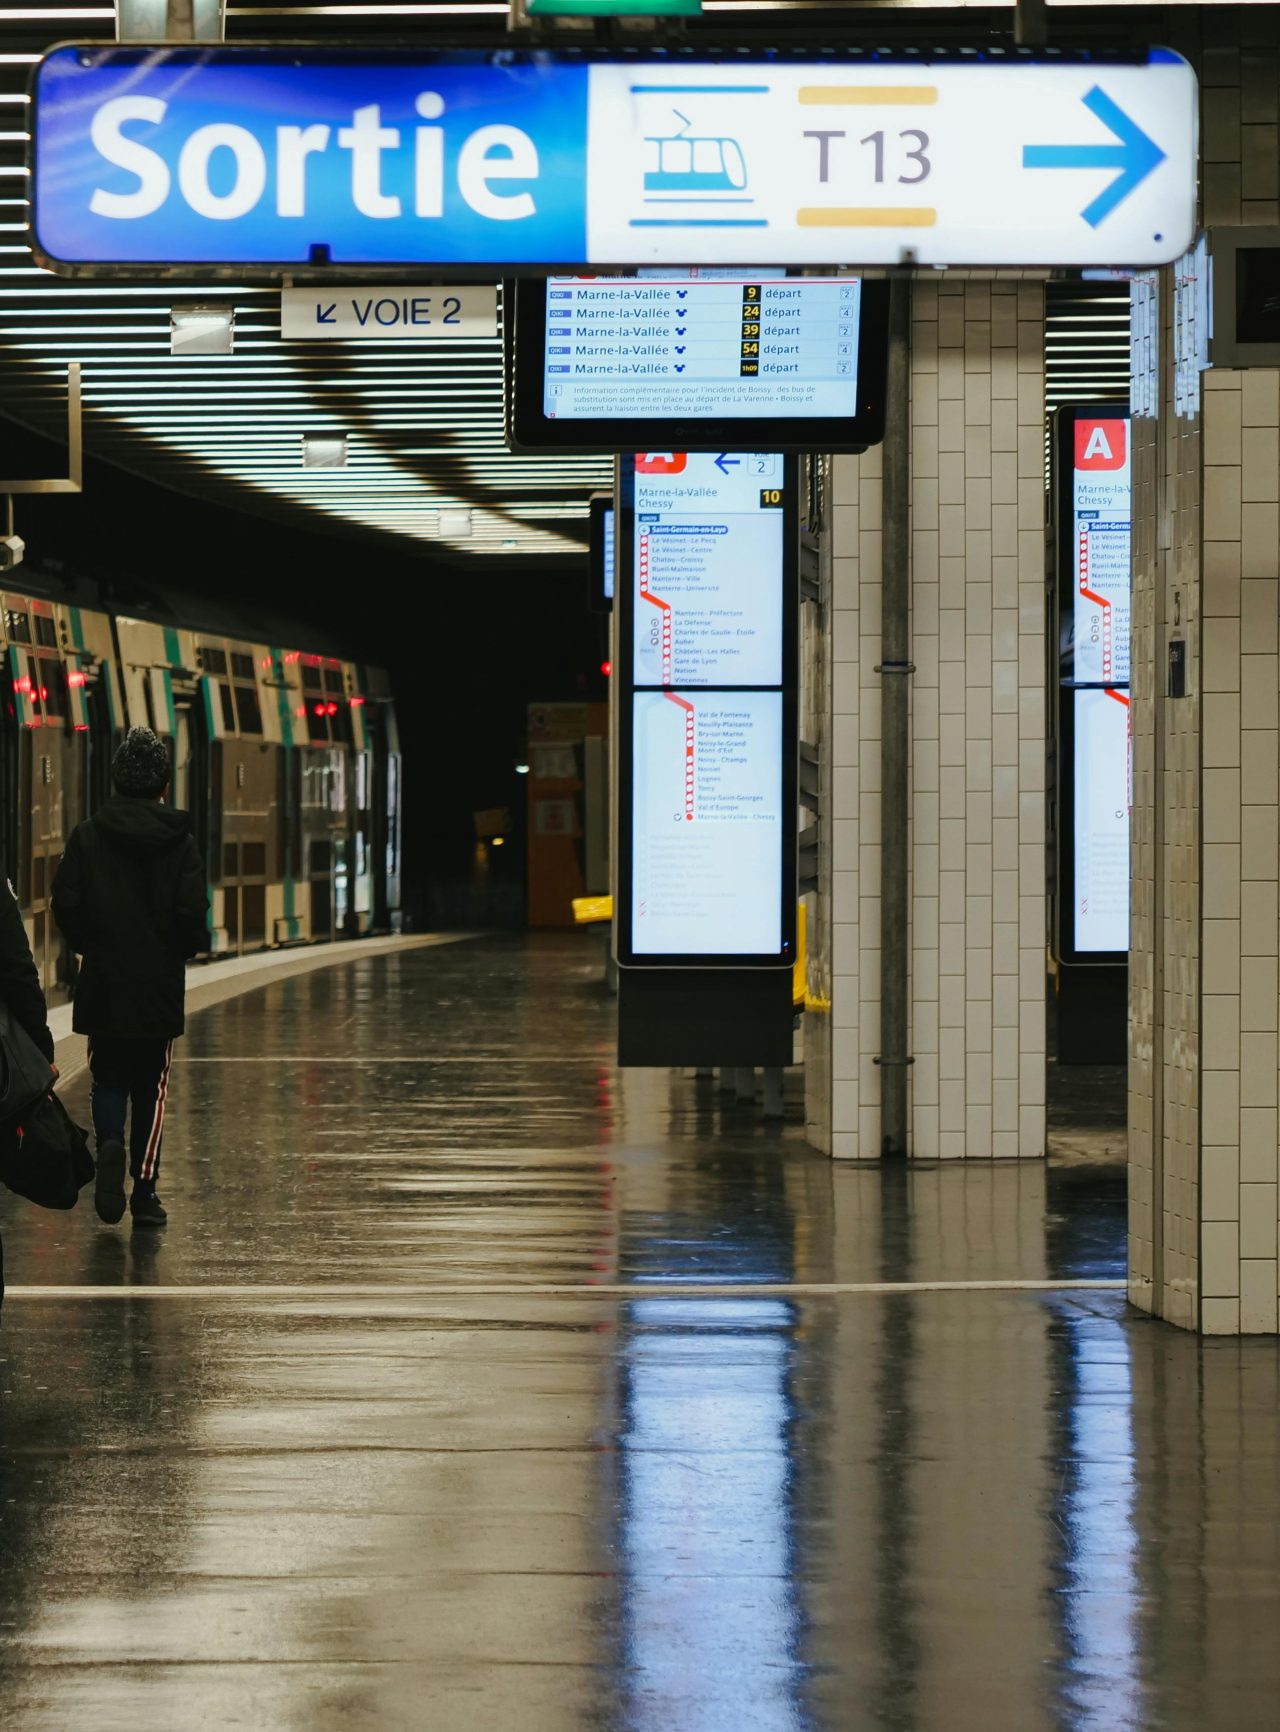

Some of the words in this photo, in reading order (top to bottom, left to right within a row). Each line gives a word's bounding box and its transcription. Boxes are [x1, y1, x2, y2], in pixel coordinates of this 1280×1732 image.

[89, 91, 539, 220] Sortie
[577, 290, 671, 300] Marne-la-Vallée
[748, 287, 756, 297] 9
[765, 290, 802, 300] départ
[352, 299, 431, 326] VOIE
[443, 297, 461, 324] 2
[576, 308, 670, 318] Marne-la-Vallée
[744, 306, 759, 316] 24
[764, 308, 801, 318] départ
[576, 327, 669, 337] Marne-la-Vallée
[743, 324, 759, 335] 39
[764, 327, 800, 337] départ
[575, 345, 669, 355] Marne-la-Vallée
[742, 343, 758, 354] 54
[763, 345, 800, 355] départ
[575, 364, 668, 374] Marne-la-Vallée
[762, 364, 799, 374] départ
[620, 387, 679, 395] complémentaire
[748, 387, 771, 395] Boissy
[664, 396, 683, 404] place
[696, 396, 720, 404] départ
[781, 395, 804, 403] Boissy
[1083, 427, 1113, 459] A
[757, 461, 765, 473] 2
[638, 487, 718, 498] Marne-la-Vallée
[762, 490, 780, 504] 10
[638, 499, 673, 510] Chessy
[1078, 496, 1113, 506] Chessy
[651, 525, 727, 535] Saint-Germain-en-Laye
